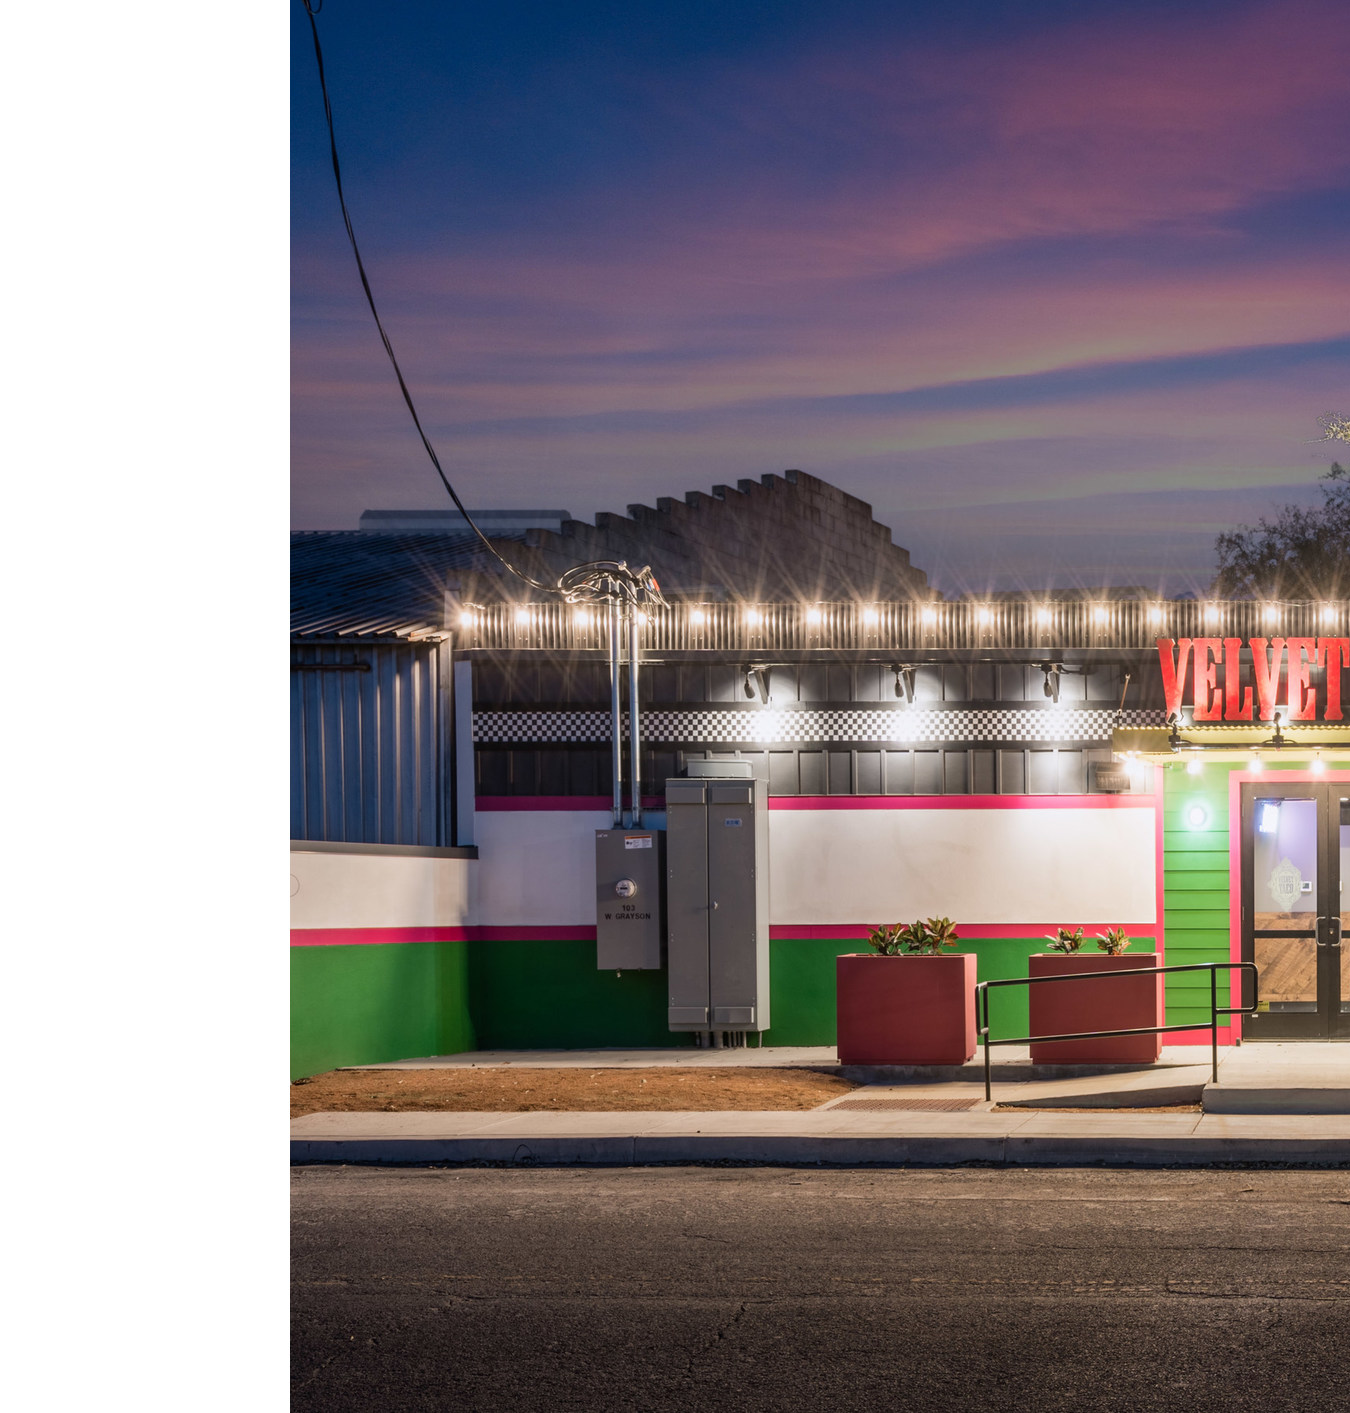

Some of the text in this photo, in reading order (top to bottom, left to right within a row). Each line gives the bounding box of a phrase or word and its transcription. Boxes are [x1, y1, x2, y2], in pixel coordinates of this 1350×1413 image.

[1156, 637, 1350, 721] VELVET
[622, 904, 636, 912] 103
[615, 912, 651, 920] GRAYSON
